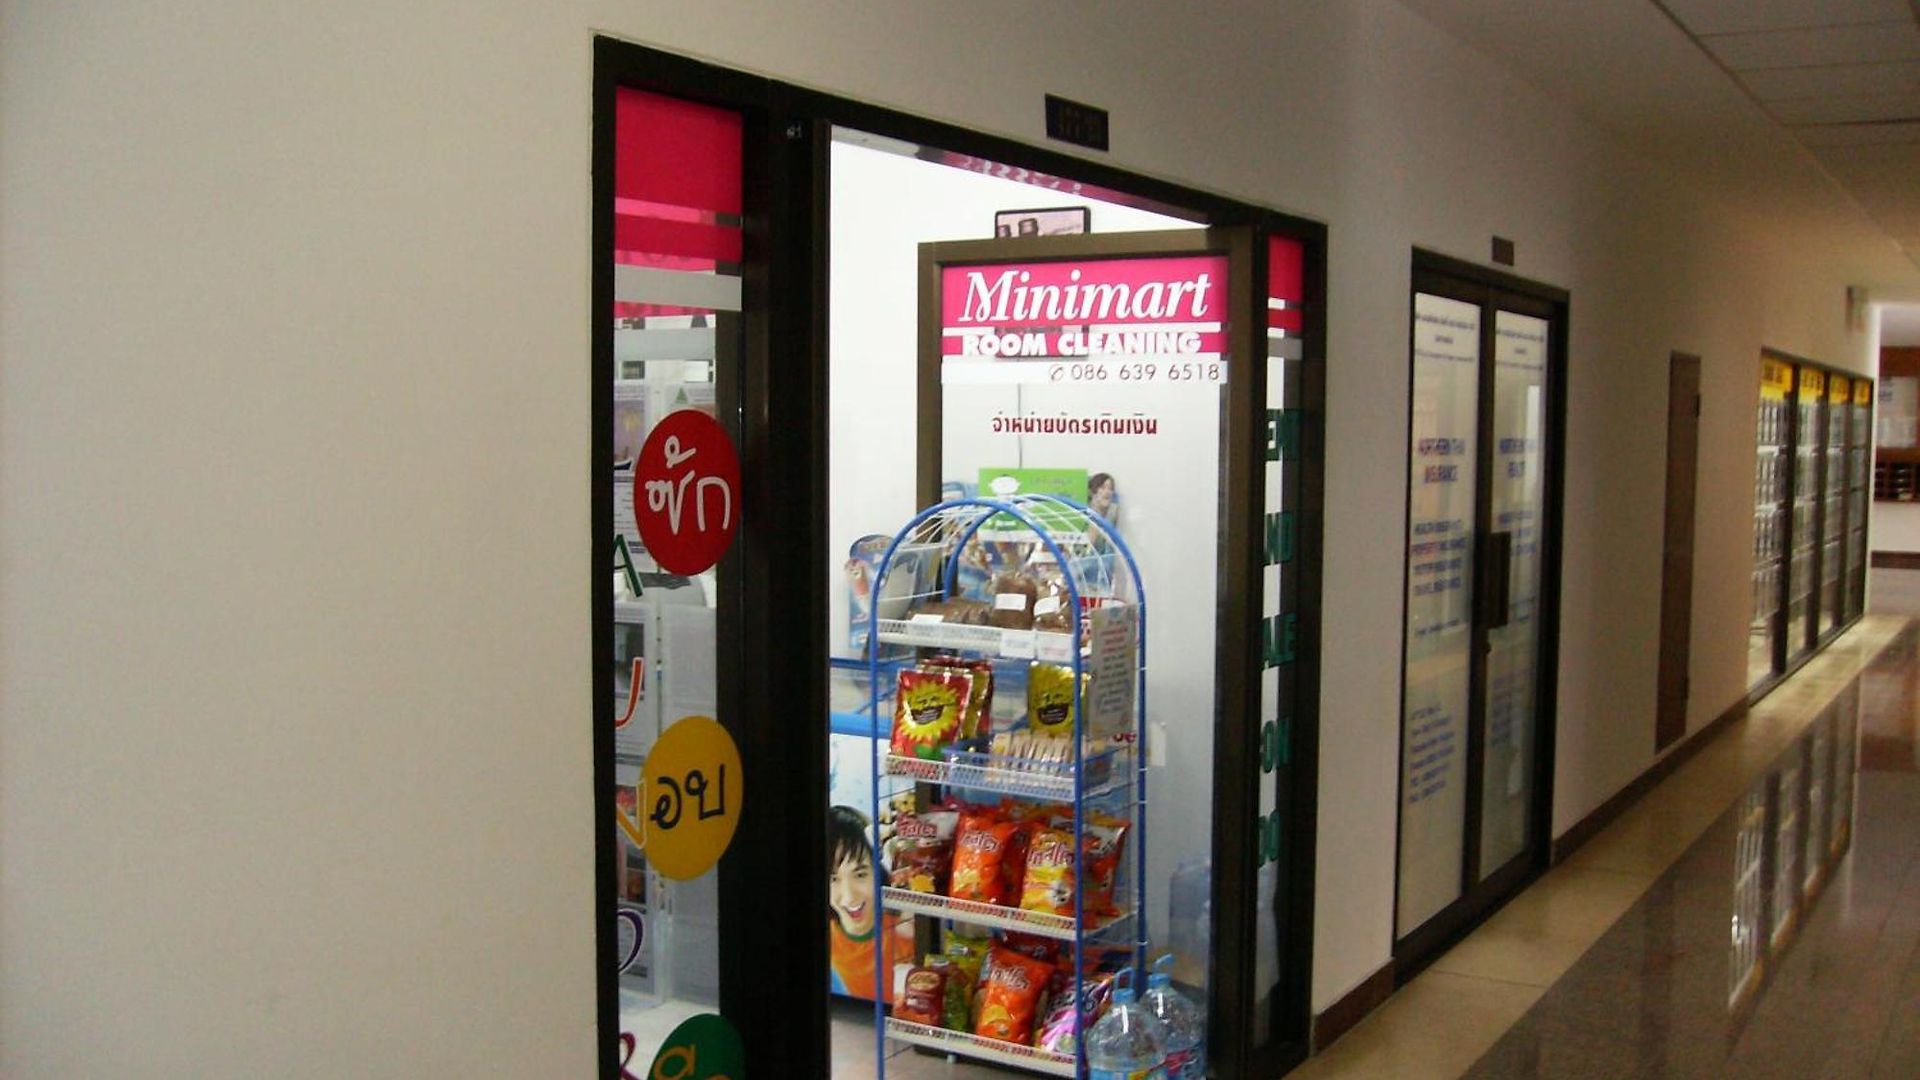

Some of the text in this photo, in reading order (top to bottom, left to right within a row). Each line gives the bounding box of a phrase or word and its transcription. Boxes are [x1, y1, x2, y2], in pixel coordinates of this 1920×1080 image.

[958, 269, 1212, 322] Minimart
[961, 331, 1201, 357] ROOM CLEANING
[1071, 363, 1220, 381] 086 639 6518
[649, 763, 725, 830] อบ
